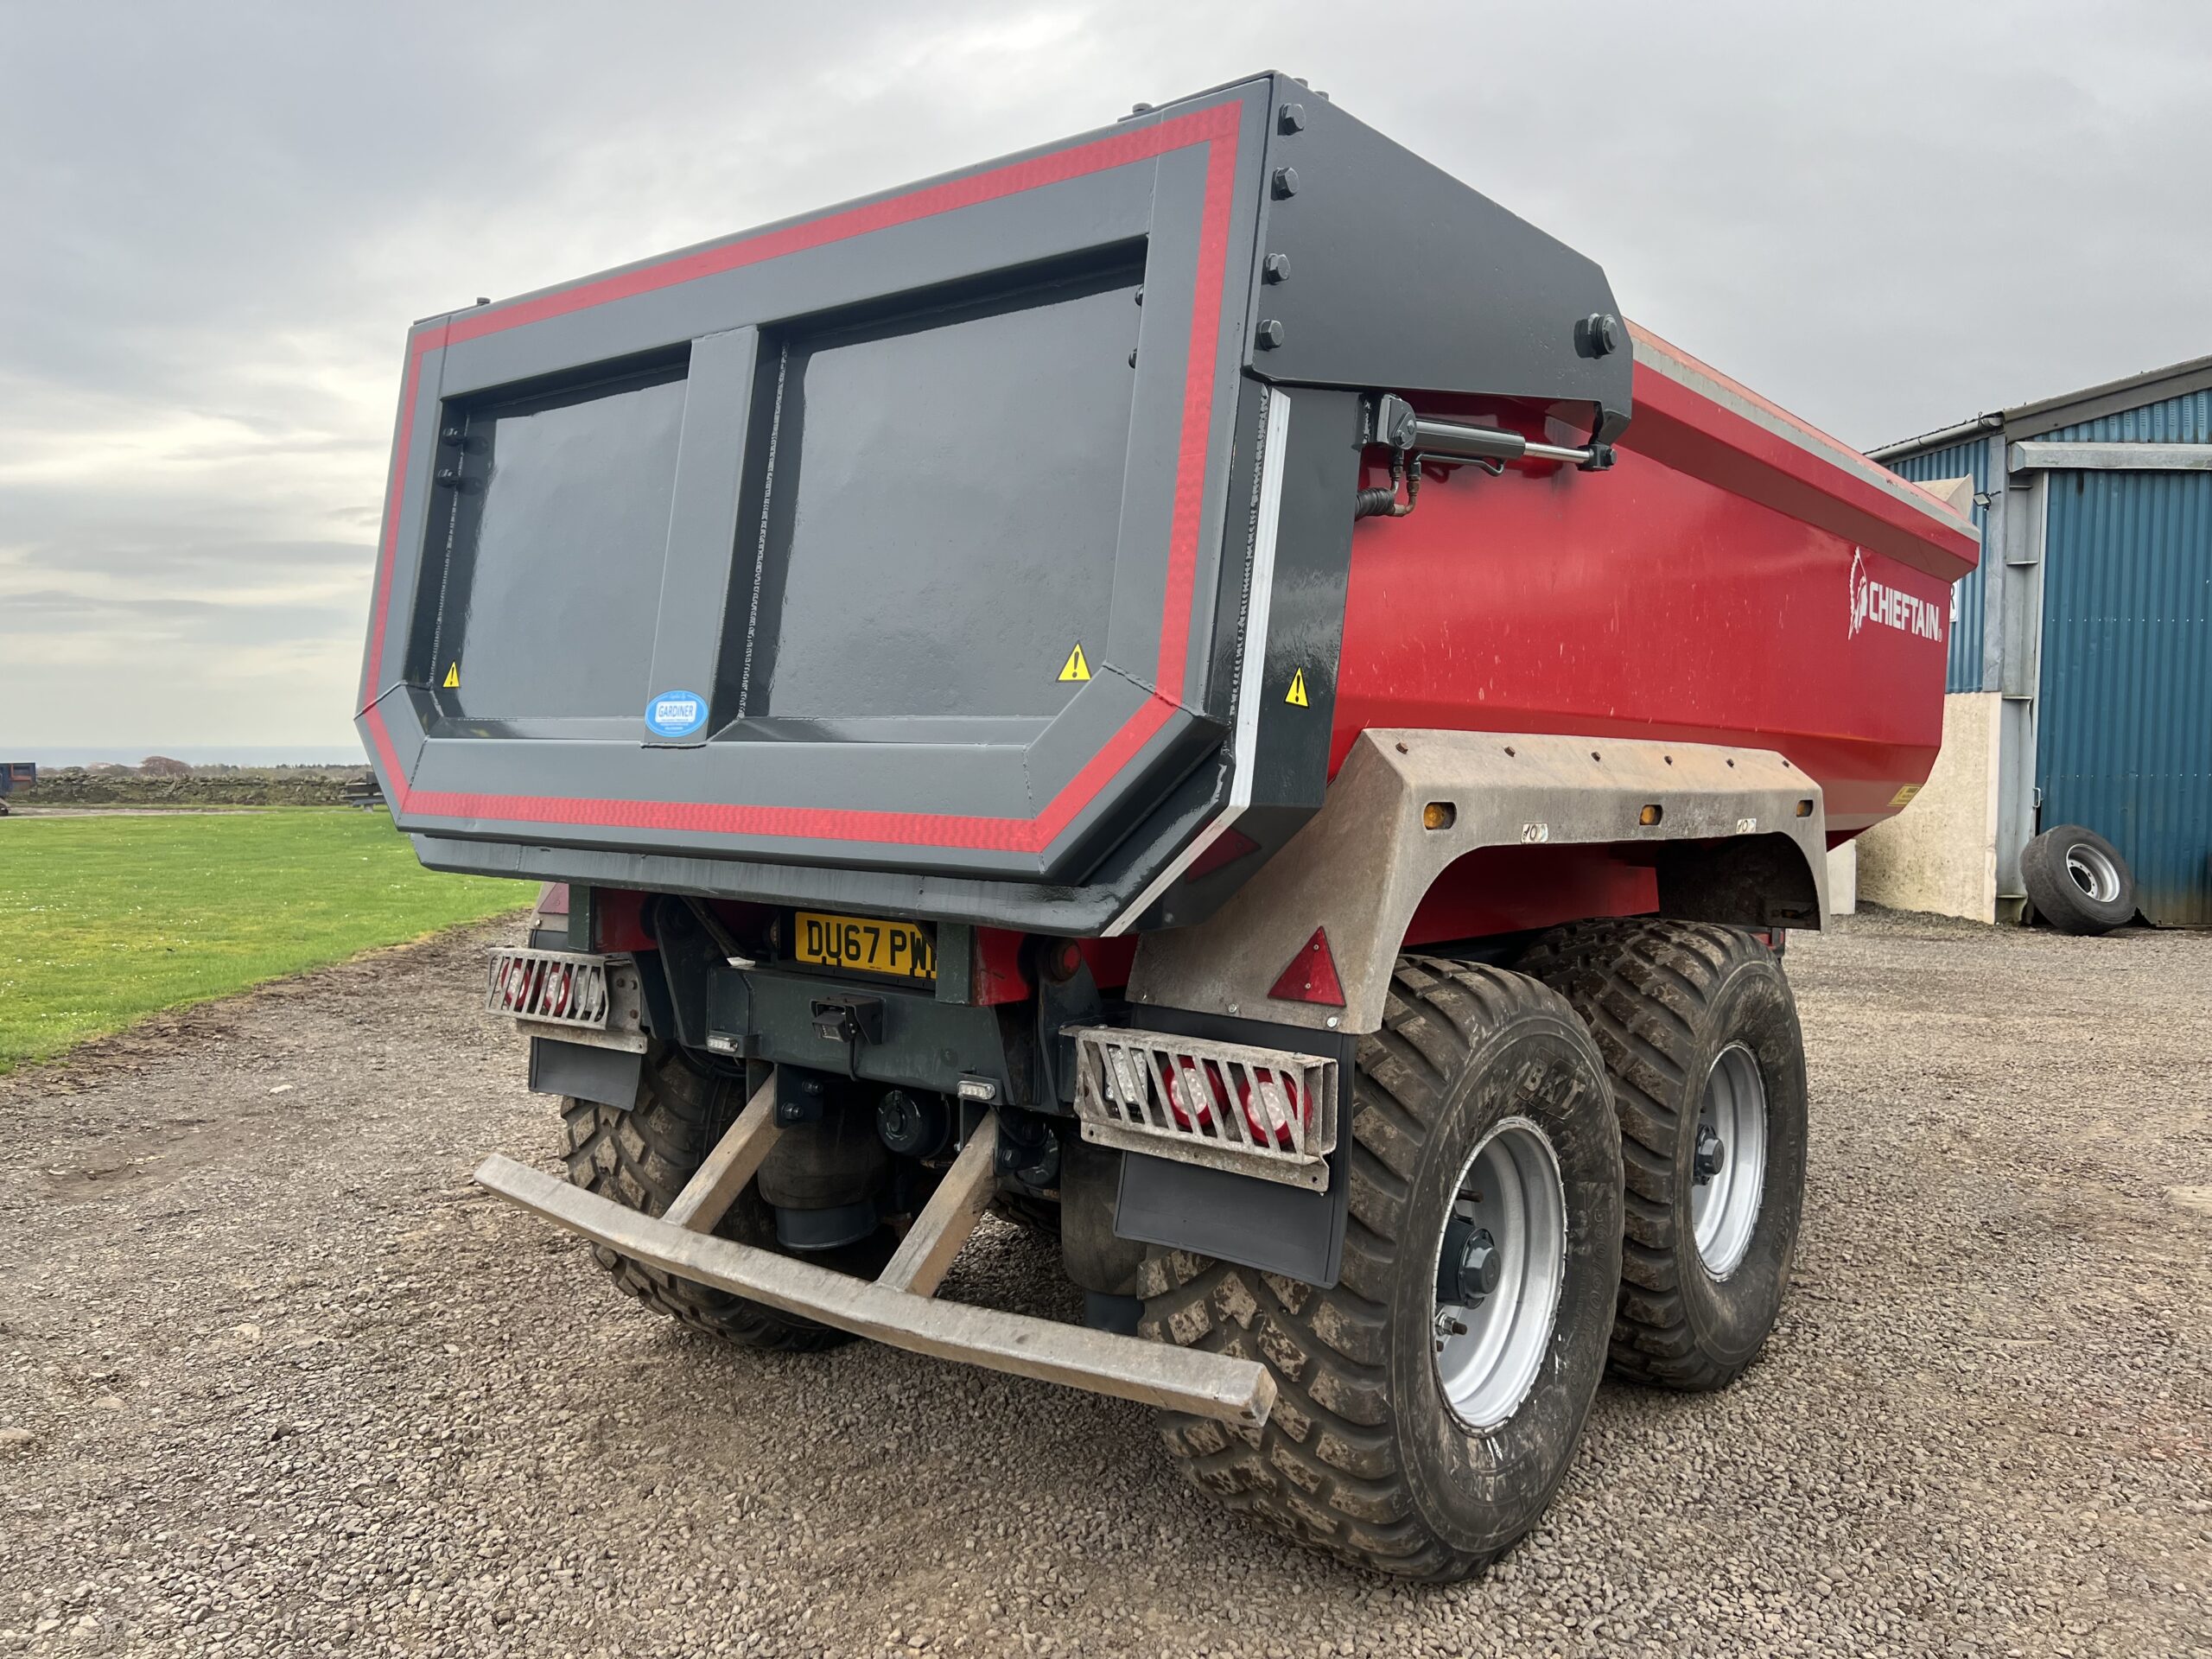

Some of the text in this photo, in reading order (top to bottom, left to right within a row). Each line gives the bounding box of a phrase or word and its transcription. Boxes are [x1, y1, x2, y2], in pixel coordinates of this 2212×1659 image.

[1869, 581, 1939, 641] CHIEFTAIN
[658, 705, 693, 717] GARDINER
[806, 919, 880, 963] DU67
